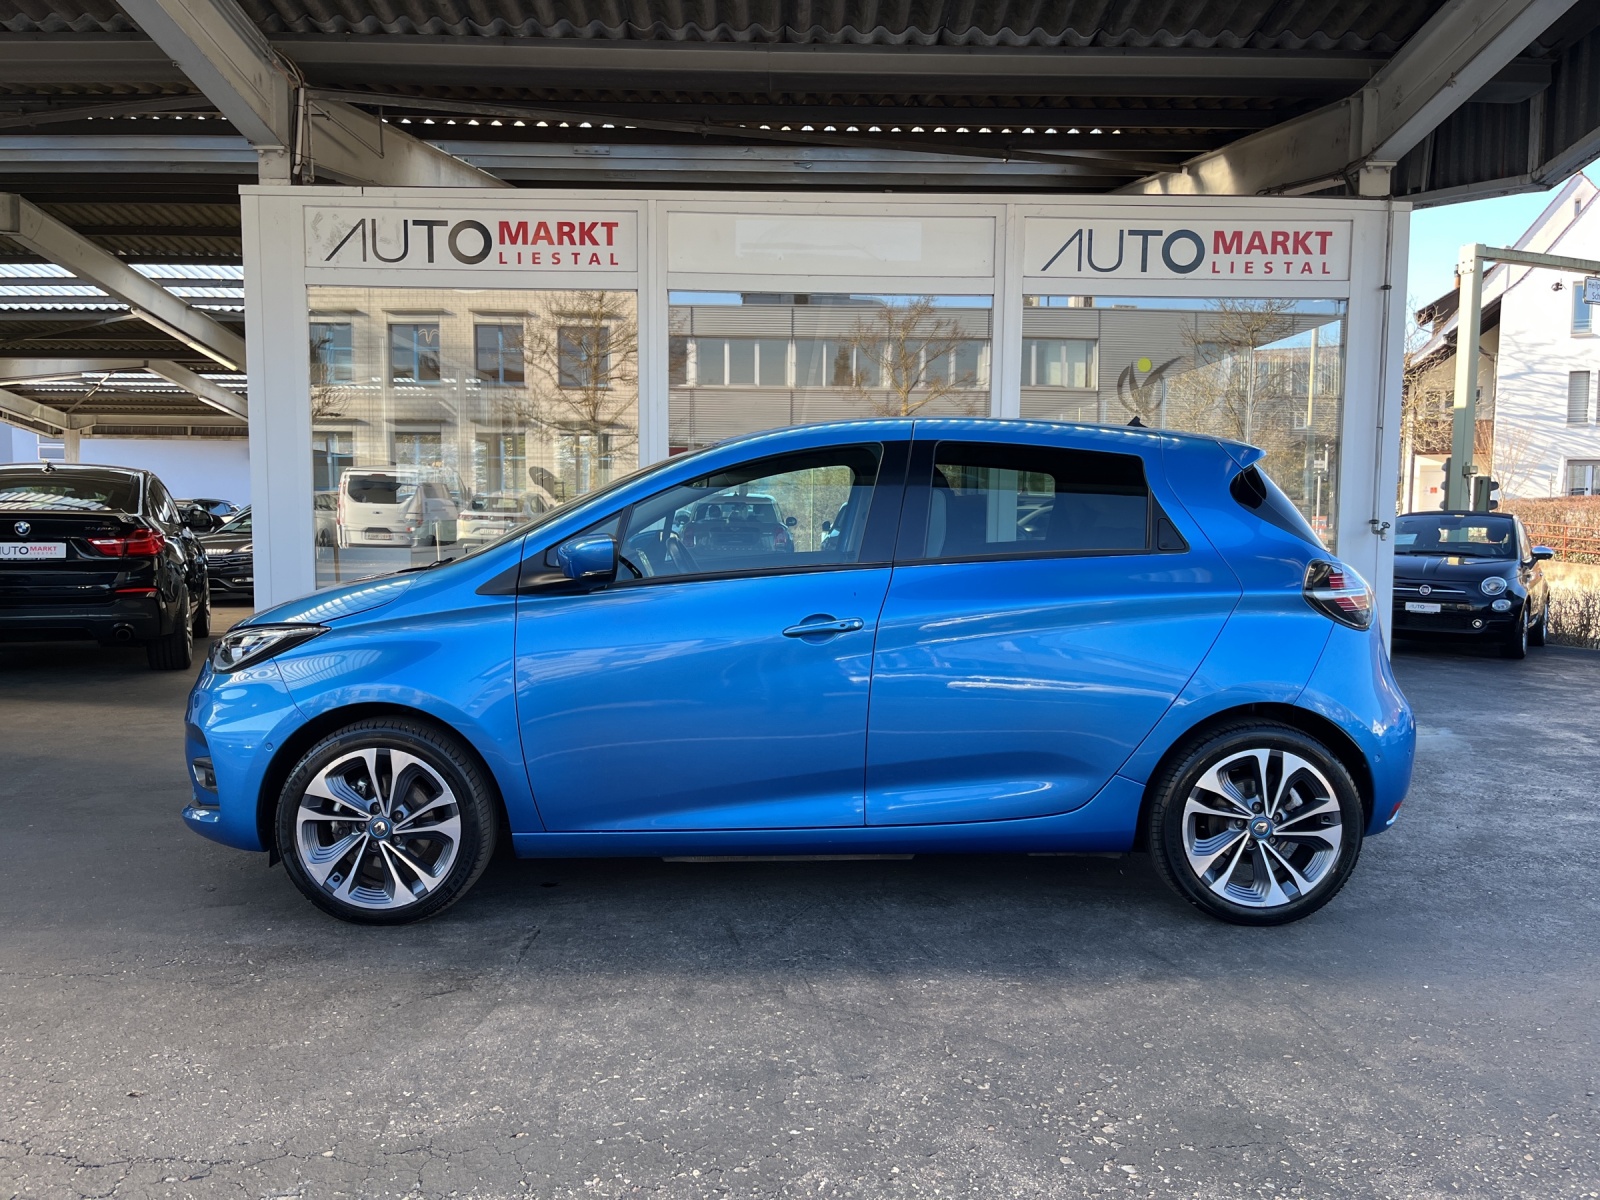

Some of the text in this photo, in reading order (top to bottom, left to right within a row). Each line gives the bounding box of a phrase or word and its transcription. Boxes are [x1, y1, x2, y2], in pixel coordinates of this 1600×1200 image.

[324, 218, 619, 265] AUTO MARKT
[499, 251, 619, 265] LIESTAL
[1040, 228, 1333, 274] AUTO MARKT
[1211, 261, 1331, 274] LIESTAL
[0, 546, 29, 555] UTO
